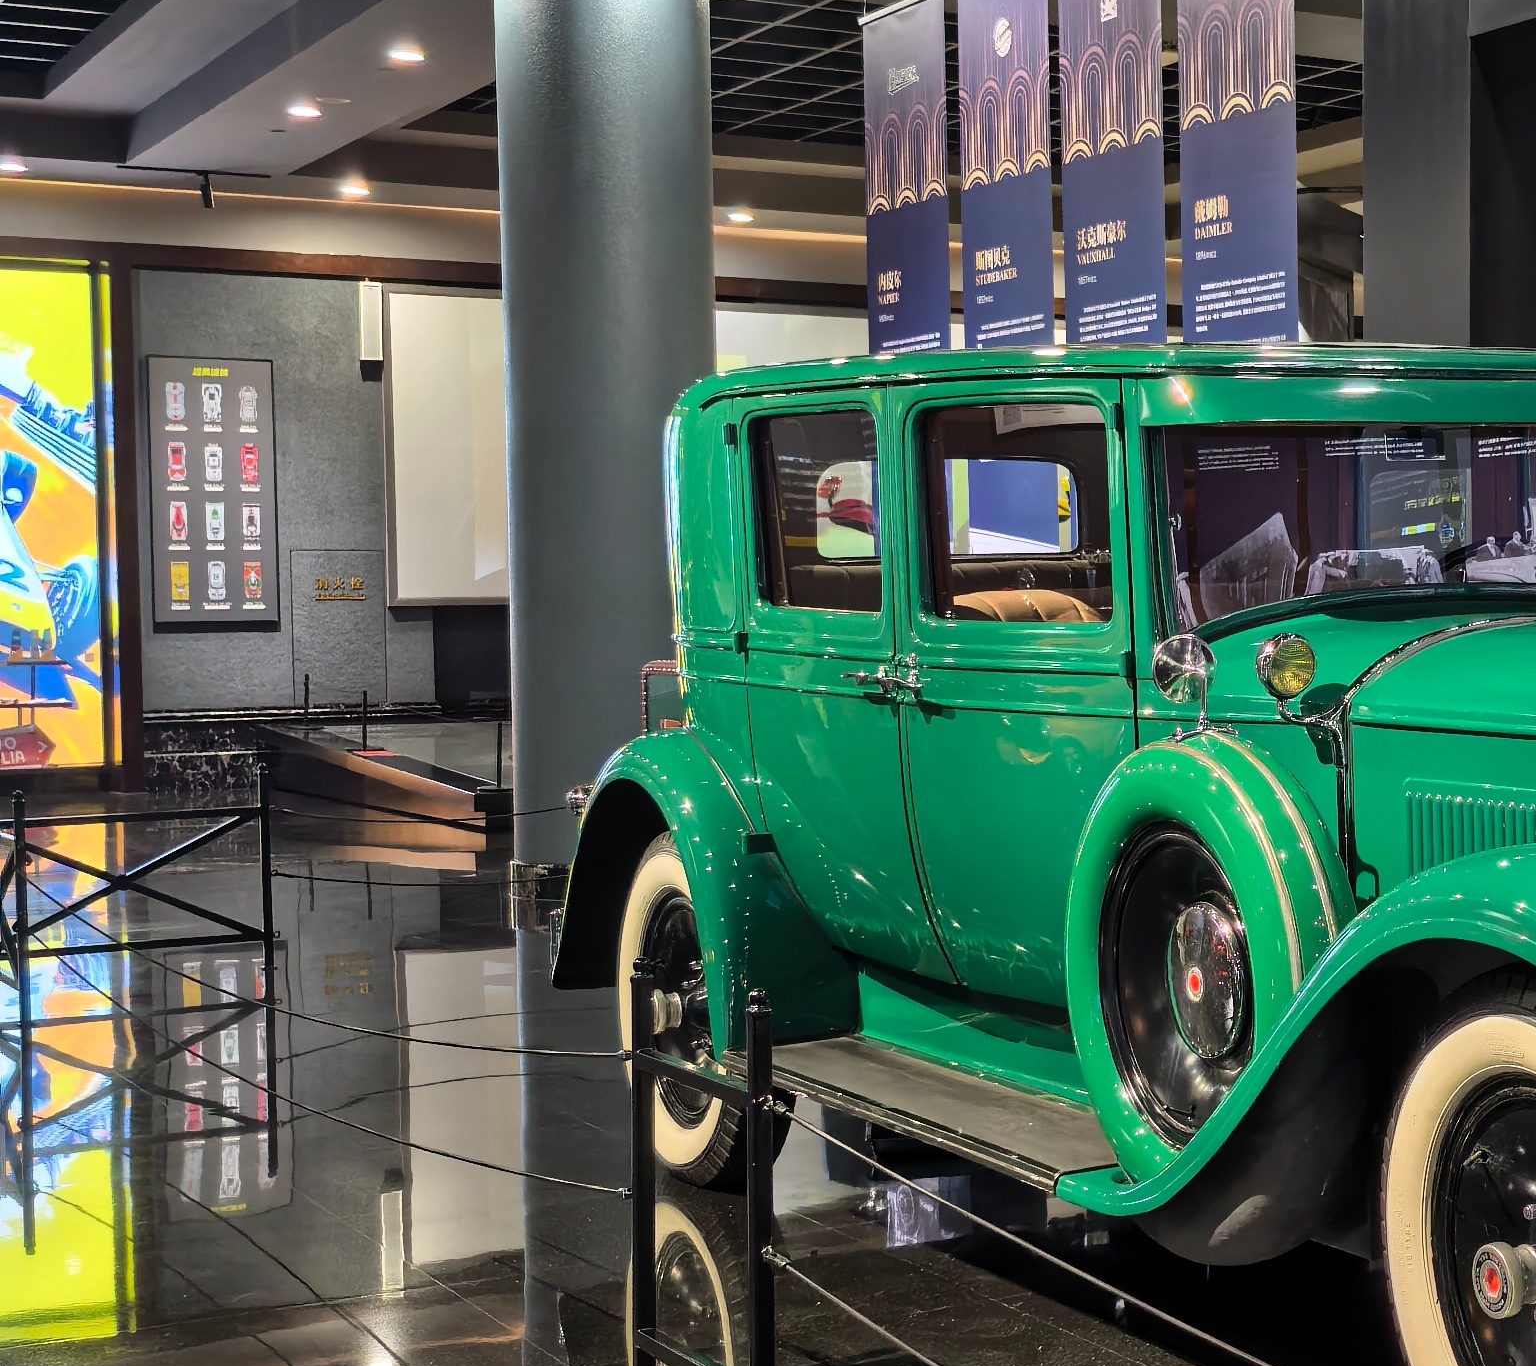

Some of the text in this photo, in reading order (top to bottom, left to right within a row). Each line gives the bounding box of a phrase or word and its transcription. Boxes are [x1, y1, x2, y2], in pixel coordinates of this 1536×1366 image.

[1077, 219, 1127, 251] 沃克斯豪尔
[1194, 221, 1234, 240] DAIMLER
[1076, 247, 1116, 266] VAUXHALL
[975, 267, 1018, 287] STUDEBAKER
